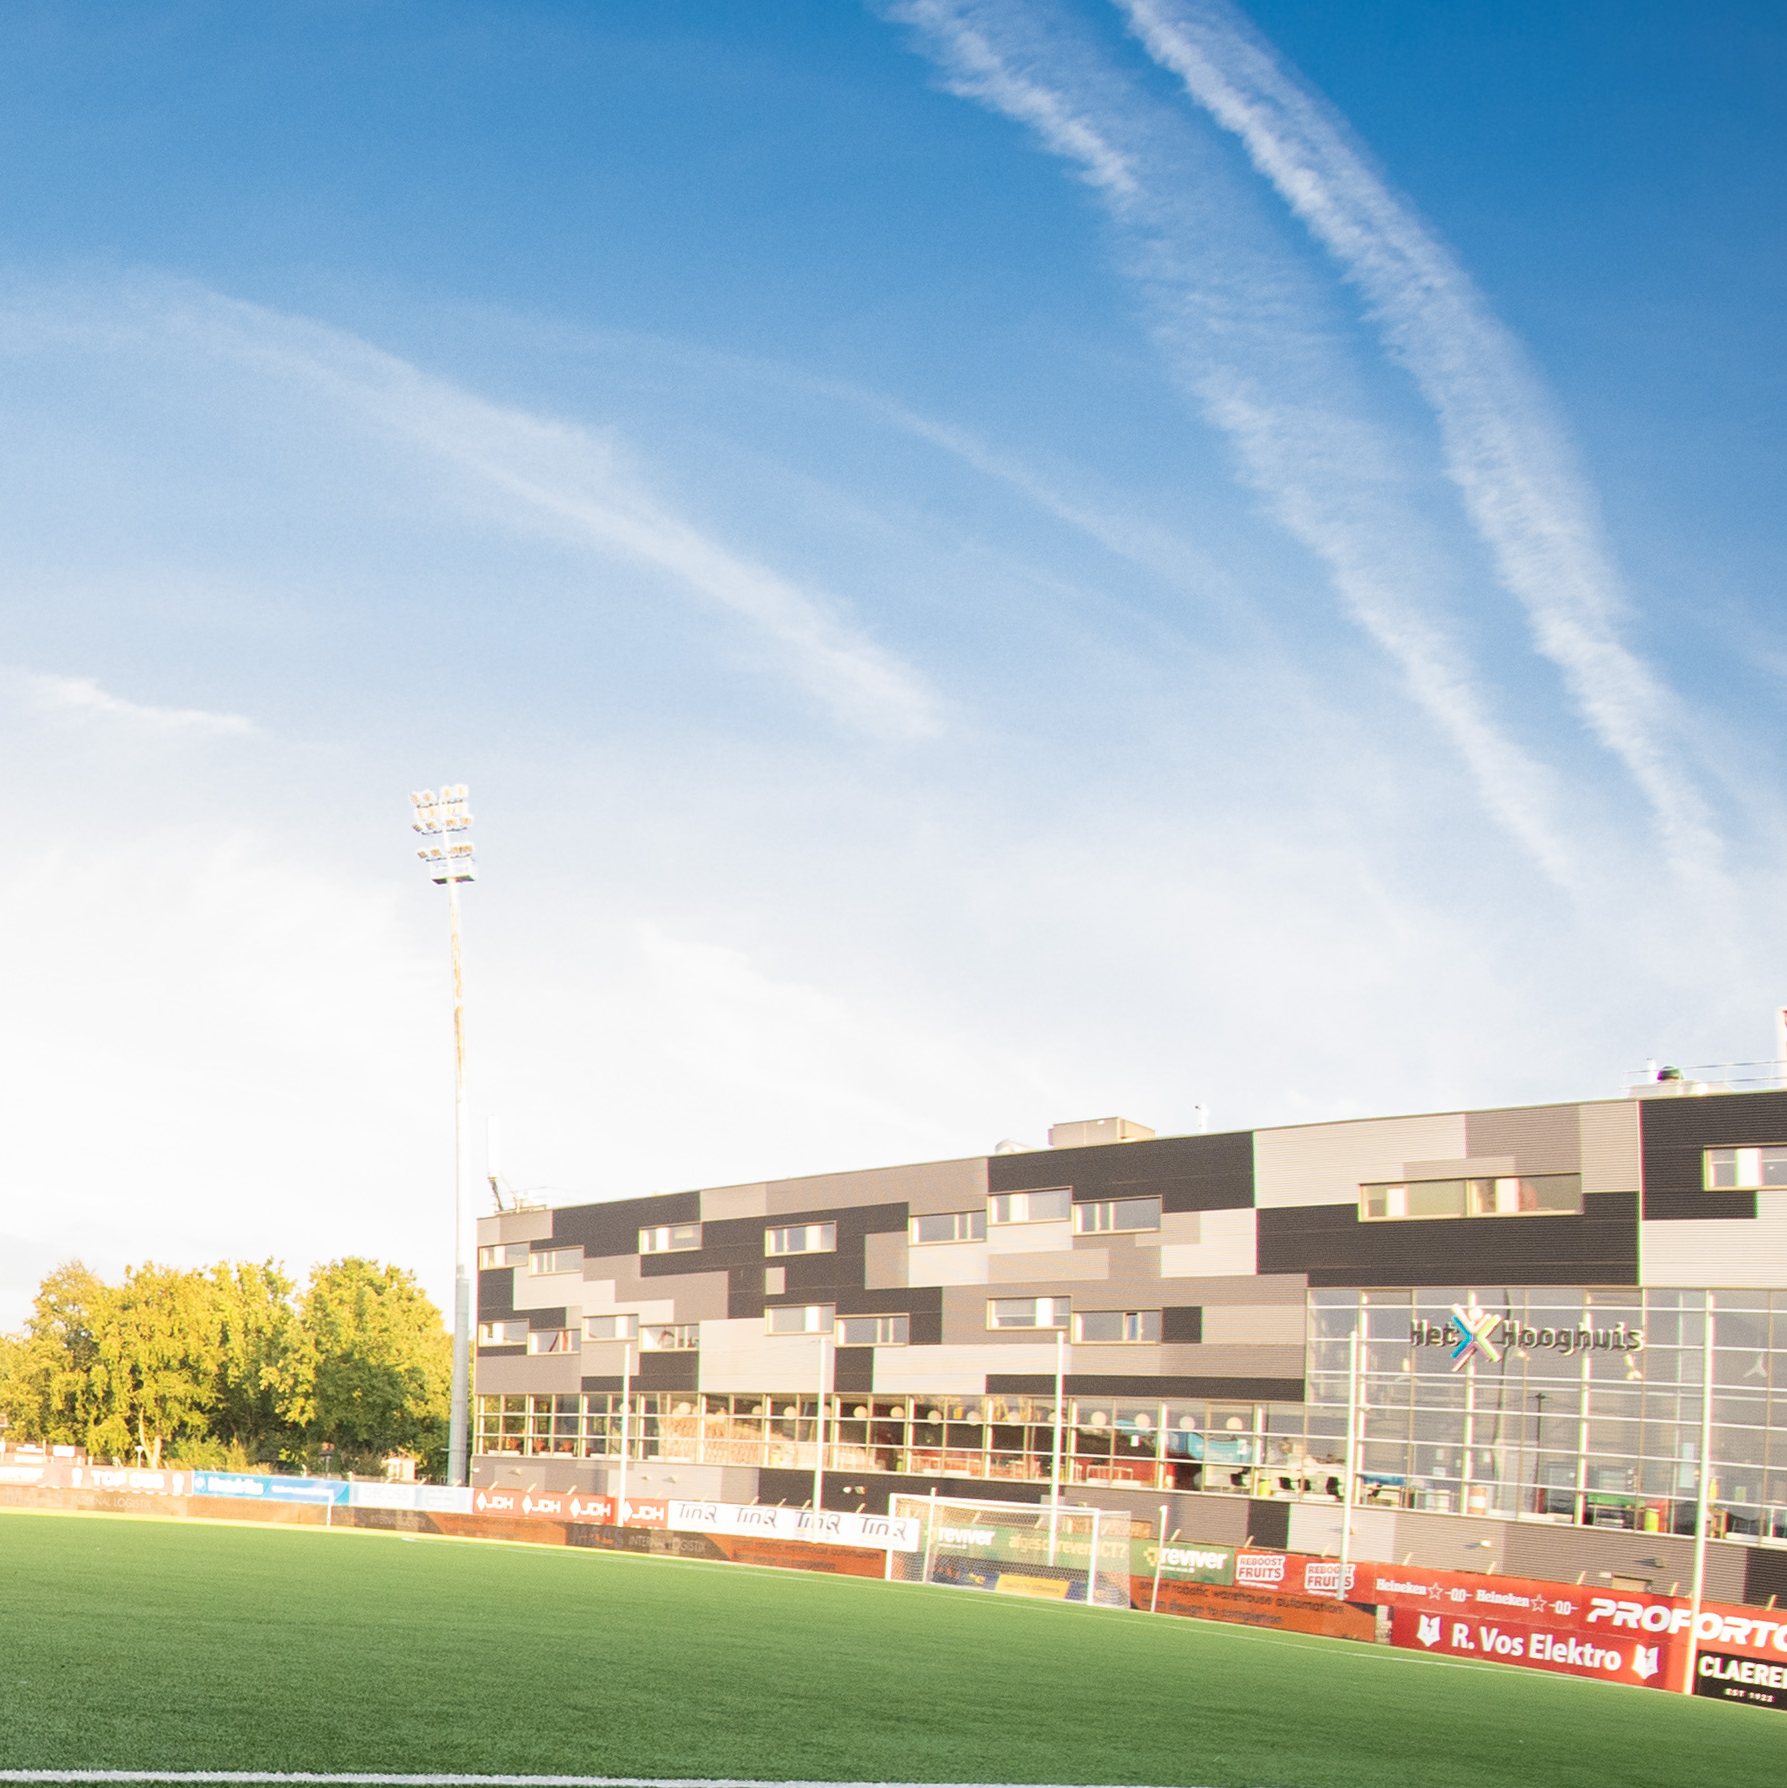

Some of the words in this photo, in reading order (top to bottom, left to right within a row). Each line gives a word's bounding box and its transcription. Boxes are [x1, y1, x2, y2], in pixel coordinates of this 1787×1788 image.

[1411, 1318, 1461, 1348] Het
[1503, 1318, 1647, 1359] Hooghuis
[486, 1496, 514, 1511] JDH
[530, 1498, 562, 1514] JDH
[579, 1502, 612, 1517] JDH
[631, 1505, 665, 1521] JDH
[677, 1502, 718, 1527] TinQ
[734, 1506, 778, 1534] TinQ
[857, 1515, 907, 1546] TinQ
[938, 1527, 996, 1546] reviver
[1162, 1546, 1228, 1570] reviver
[1240, 1556, 1283, 1567] REBOOST
[1239, 1566, 1283, 1580] FRUITS
[1376, 1578, 1428, 1597] Heineken
[1173, 1581, 1210, 1599] robotic
[1213, 1588, 1275, 1607] warehouse
[1276, 1595, 1345, 1615] automation
[1475, 1589, 1531, 1608] Heineken
[1452, 1622, 1476, 1650] R.
[1479, 1625, 1525, 1657] Vos
[1529, 1633, 1623, 1672] Elektro
[1723, 1686, 1746, 1698] EST
